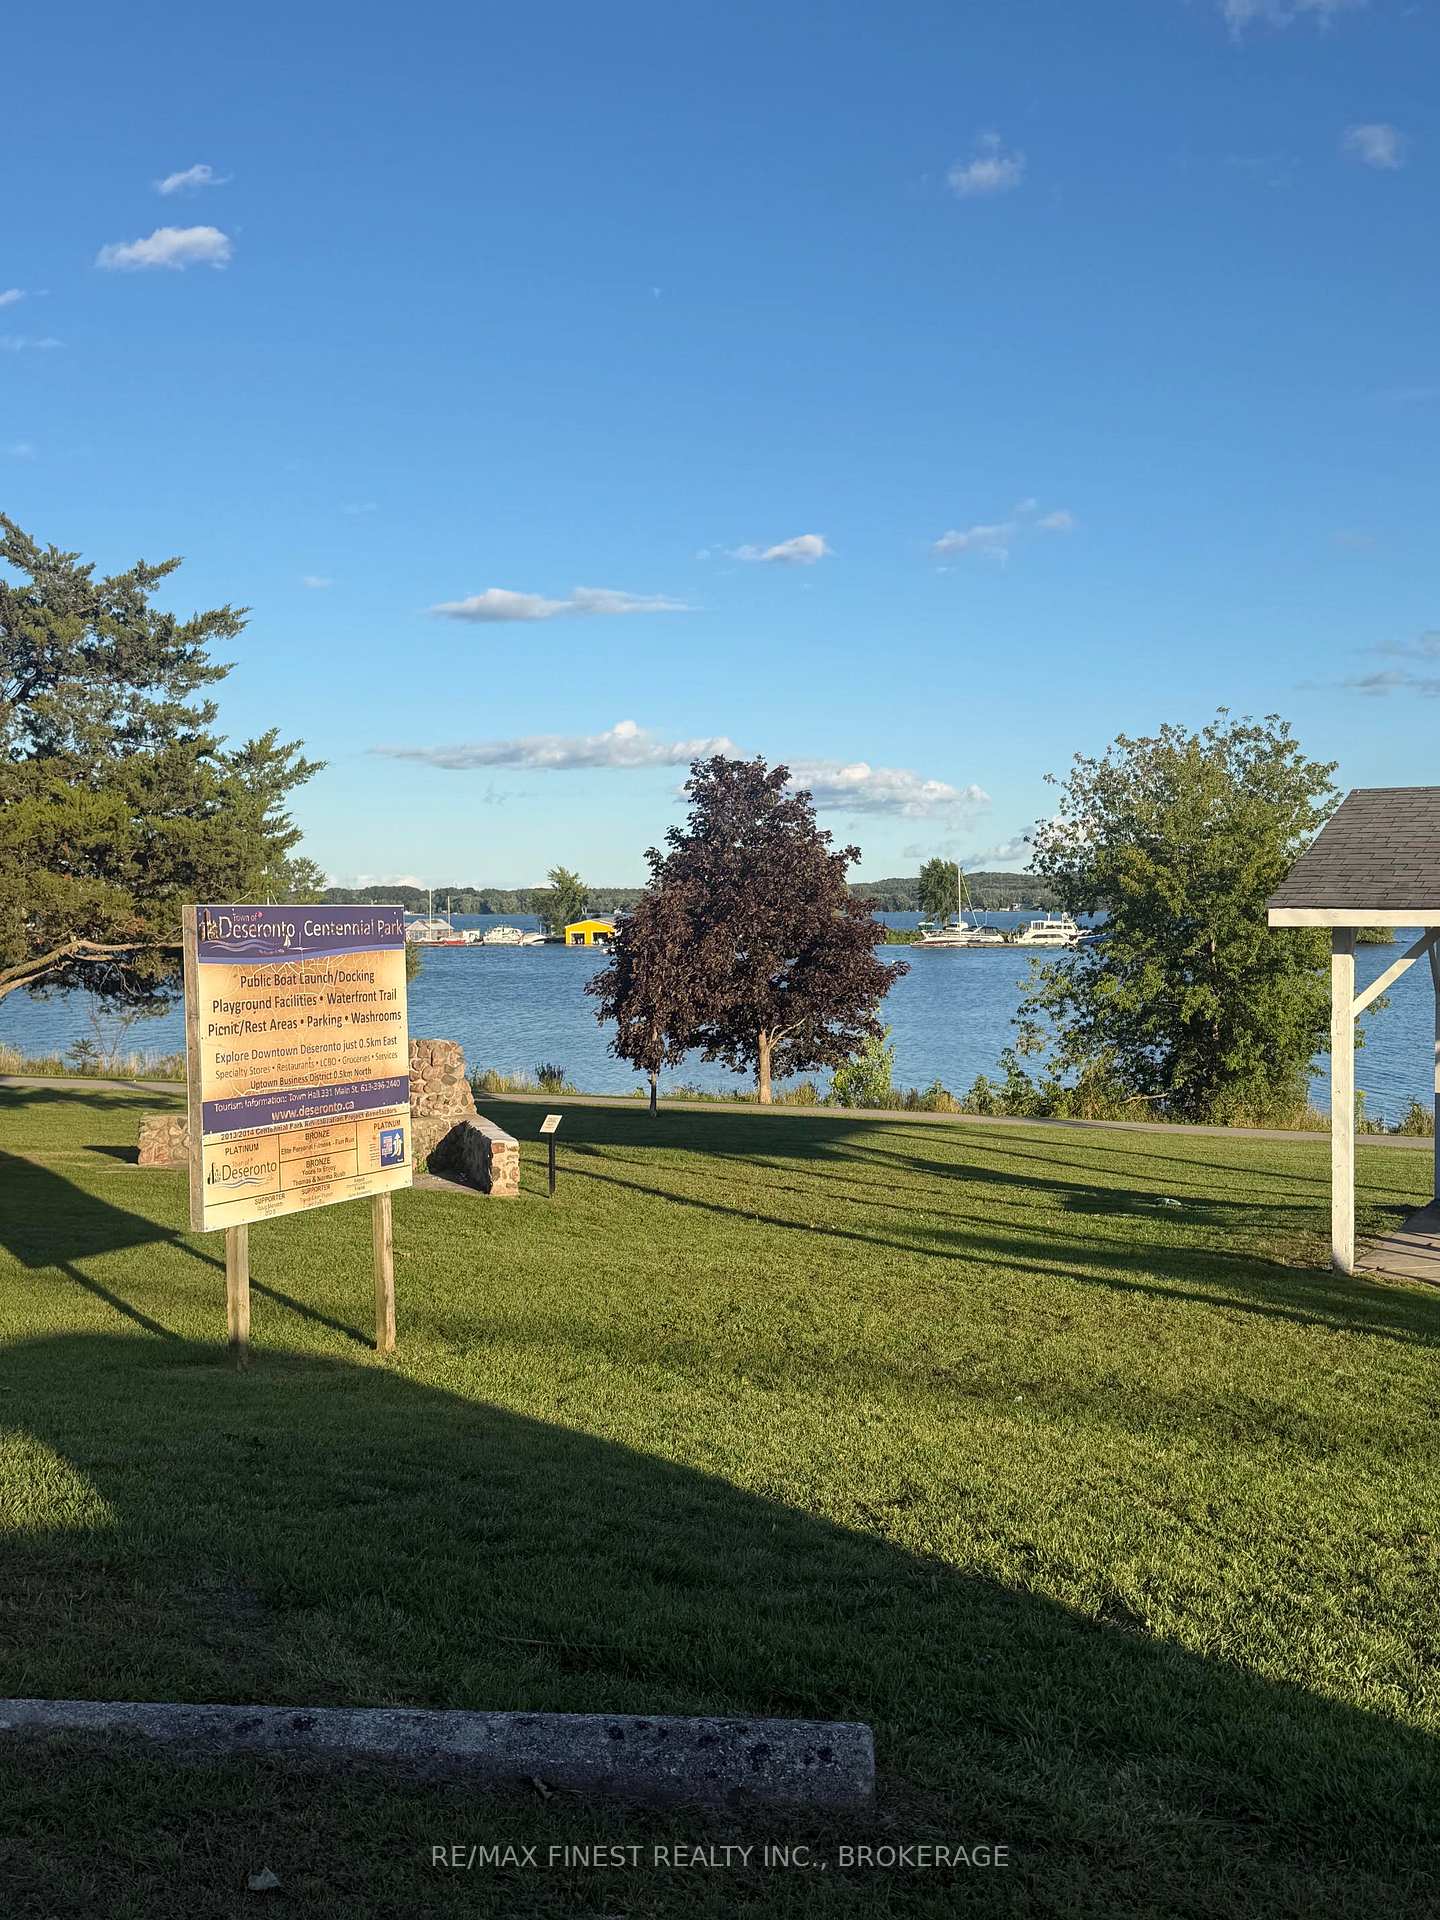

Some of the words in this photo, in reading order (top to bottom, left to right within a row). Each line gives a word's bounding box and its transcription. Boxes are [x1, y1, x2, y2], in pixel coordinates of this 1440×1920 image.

[219, 916, 295, 938] Deseronto
[304, 919, 374, 936] Centennial
[377, 919, 403, 935] Park
[240, 973, 271, 988] Public
[274, 974, 297, 986] Boat
[300, 969, 375, 985] Launch/Docking
[212, 996, 272, 1015] Playground
[274, 994, 317, 1008] Facilities
[327, 990, 377, 1005] Waterfront
[379, 988, 397, 1001] Trail
[208, 1019, 267, 1037] Picnic/Rest
[269, 1019, 298, 1031] Areas
[307, 1014, 343, 1028] Parking
[350, 1010, 402, 1024] Washrooms
[215, 1050, 250, 1065] Explore
[251, 1047, 298, 1060] Downtown
[300, 1042, 341, 1055] Deseronto
[343, 1040, 357, 1052] just
[358, 1037, 382, 1049] 0.5km
[383, 1036, 398, 1046] East
[215, 1067, 248, 1080] Specialty
[249, 1065, 271, 1076] Stores
[276, 1061, 315, 1072] Restaurants
[319, 1057, 337, 1067] LCBO
[342, 1055, 371, 1065] Groceries
[375, 1051, 398, 1061] Services
[250, 1079, 278, 1090] Uptown
[279, 1075, 309, 1086] Business
[309, 1072, 332, 1082] District
[333, 1070, 353, 1079] 0.5km
[354, 1067, 372, 1076] North
[288, 1093, 307, 1102] Town
[334, 1086, 350, 1096] Main
[271, 1101, 355, 1121] www.deseronto.ca
[373, 1119, 401, 1130] PLATINUM
[304, 1129, 331, 1141] BRONZE
[224, 1143, 259, 1156] PLATINUM
[222, 1161, 277, 1181] Deseronto
[305, 1157, 331, 1168] BRONZE
[254, 1192, 286, 1206] SUPPORTER
